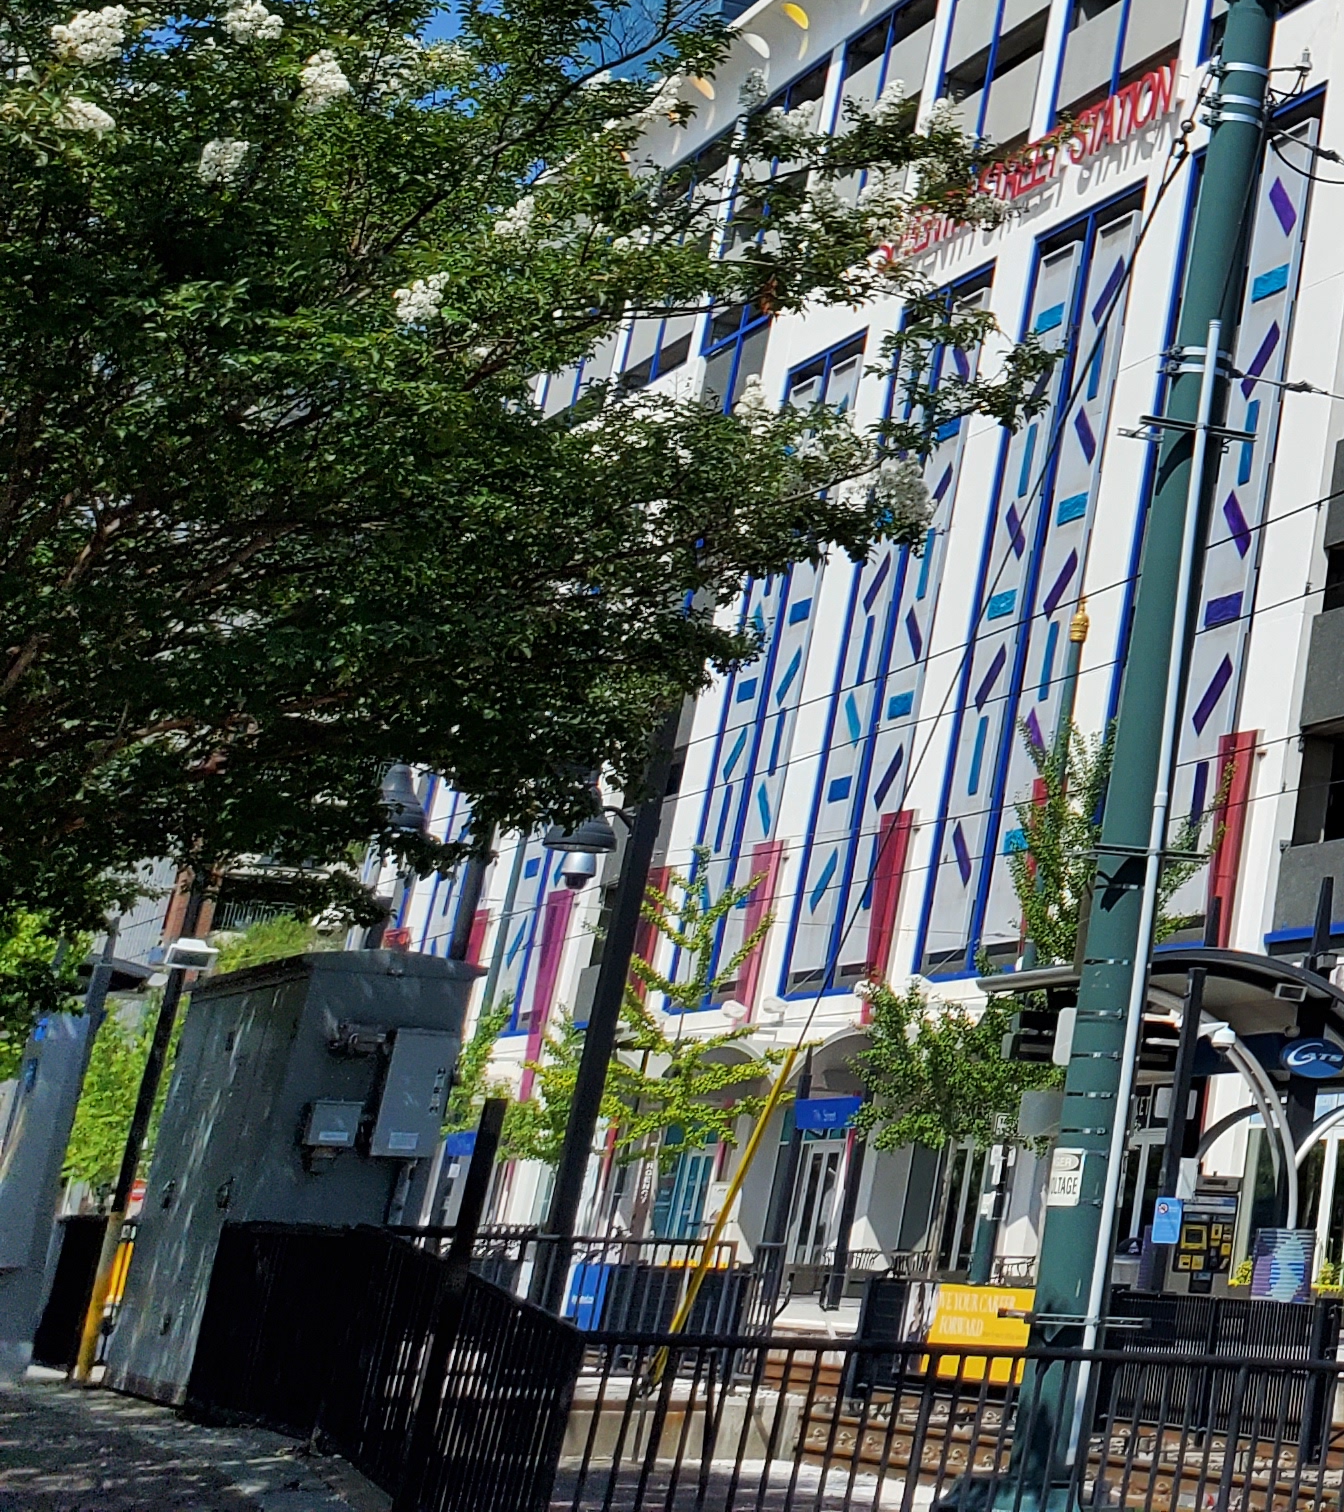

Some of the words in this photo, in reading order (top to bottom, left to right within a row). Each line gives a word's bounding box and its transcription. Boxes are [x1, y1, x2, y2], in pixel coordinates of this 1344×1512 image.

[1070, 59, 1178, 164] STATION
[1287, 1042, 1344, 1066] CATS
[939, 1314, 984, 1337] FORWARD
